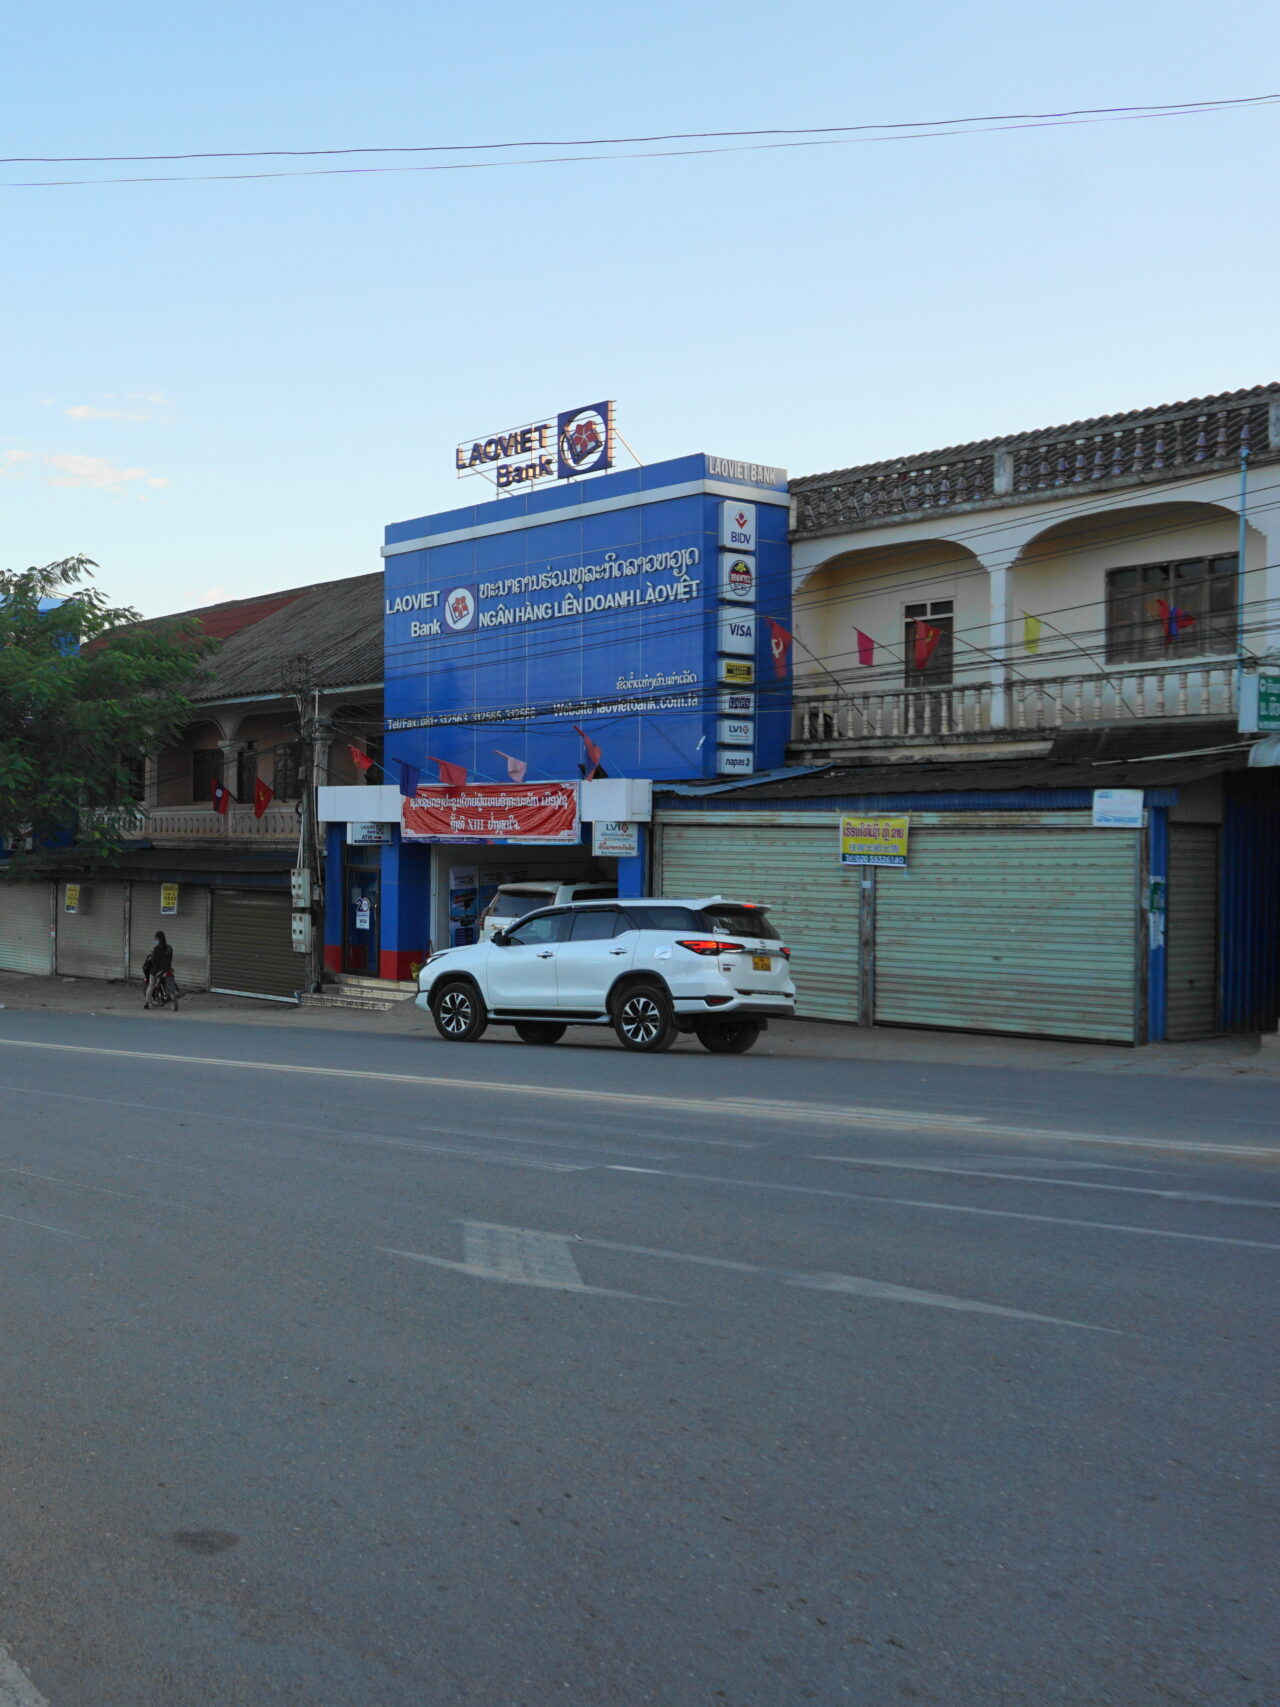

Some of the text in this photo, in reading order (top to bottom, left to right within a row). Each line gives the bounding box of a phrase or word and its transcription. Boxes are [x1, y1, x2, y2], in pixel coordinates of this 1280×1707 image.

[456, 424, 551, 469] LAOVIET
[497, 455, 554, 487] Bank
[709, 456, 776, 485] LAOVIET BANK
[731, 532, 752, 544] BIDV
[385, 590, 441, 615] LAOVIET
[479, 604, 515, 628] NGÂN
[515, 601, 552, 623] HÀNG
[554, 592, 583, 618] LIÊN
[584, 590, 634, 613] DOANH
[411, 618, 442, 638] Bank
[730, 624, 752, 638] VISA
[729, 725, 742, 733] LVI
[726, 758, 745, 768] napas
